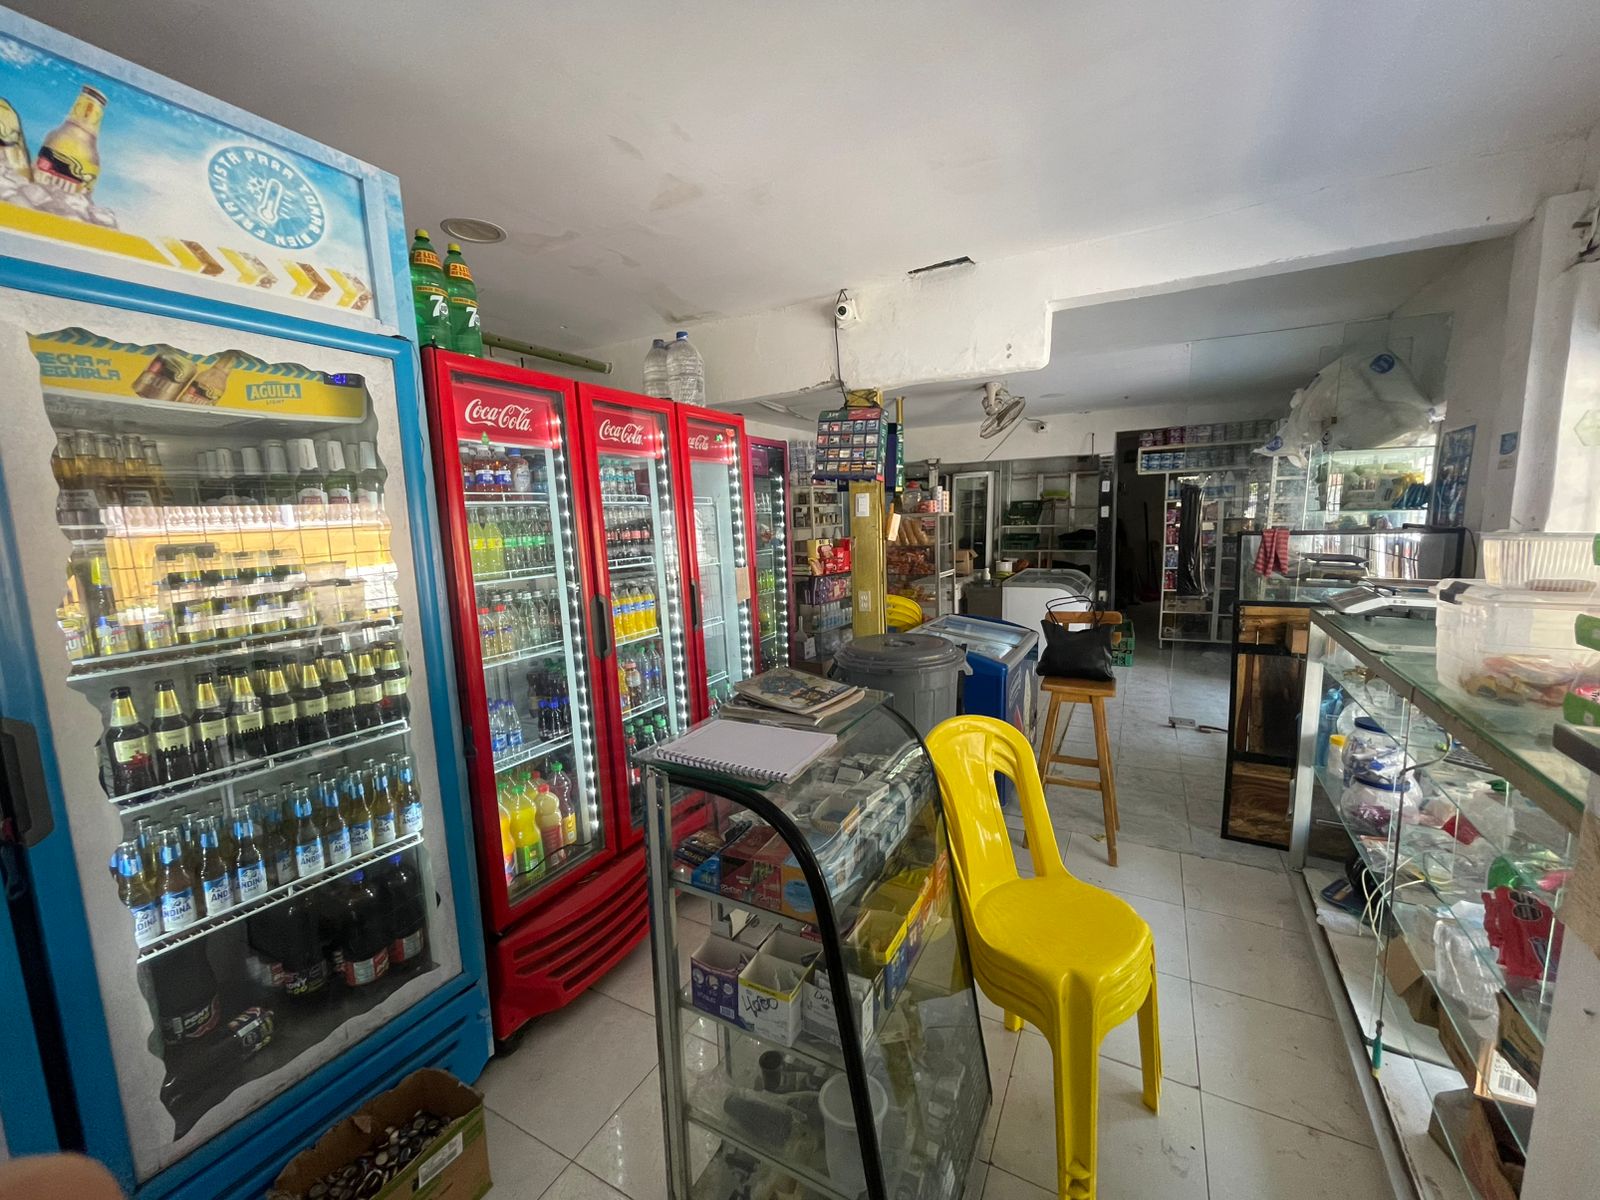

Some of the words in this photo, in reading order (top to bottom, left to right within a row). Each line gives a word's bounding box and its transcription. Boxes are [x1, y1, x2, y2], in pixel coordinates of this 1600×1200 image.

[243, 151, 294, 179] PARA
[300, 184, 322, 234] TOMAR
[274, 234, 313, 247] BIEN
[250, 384, 298, 399] AGUILA
[465, 399, 532, 431] Coca-Cola
[600, 419, 642, 445] Coca-Cola
[688, 435, 709, 450] ca-Cola
